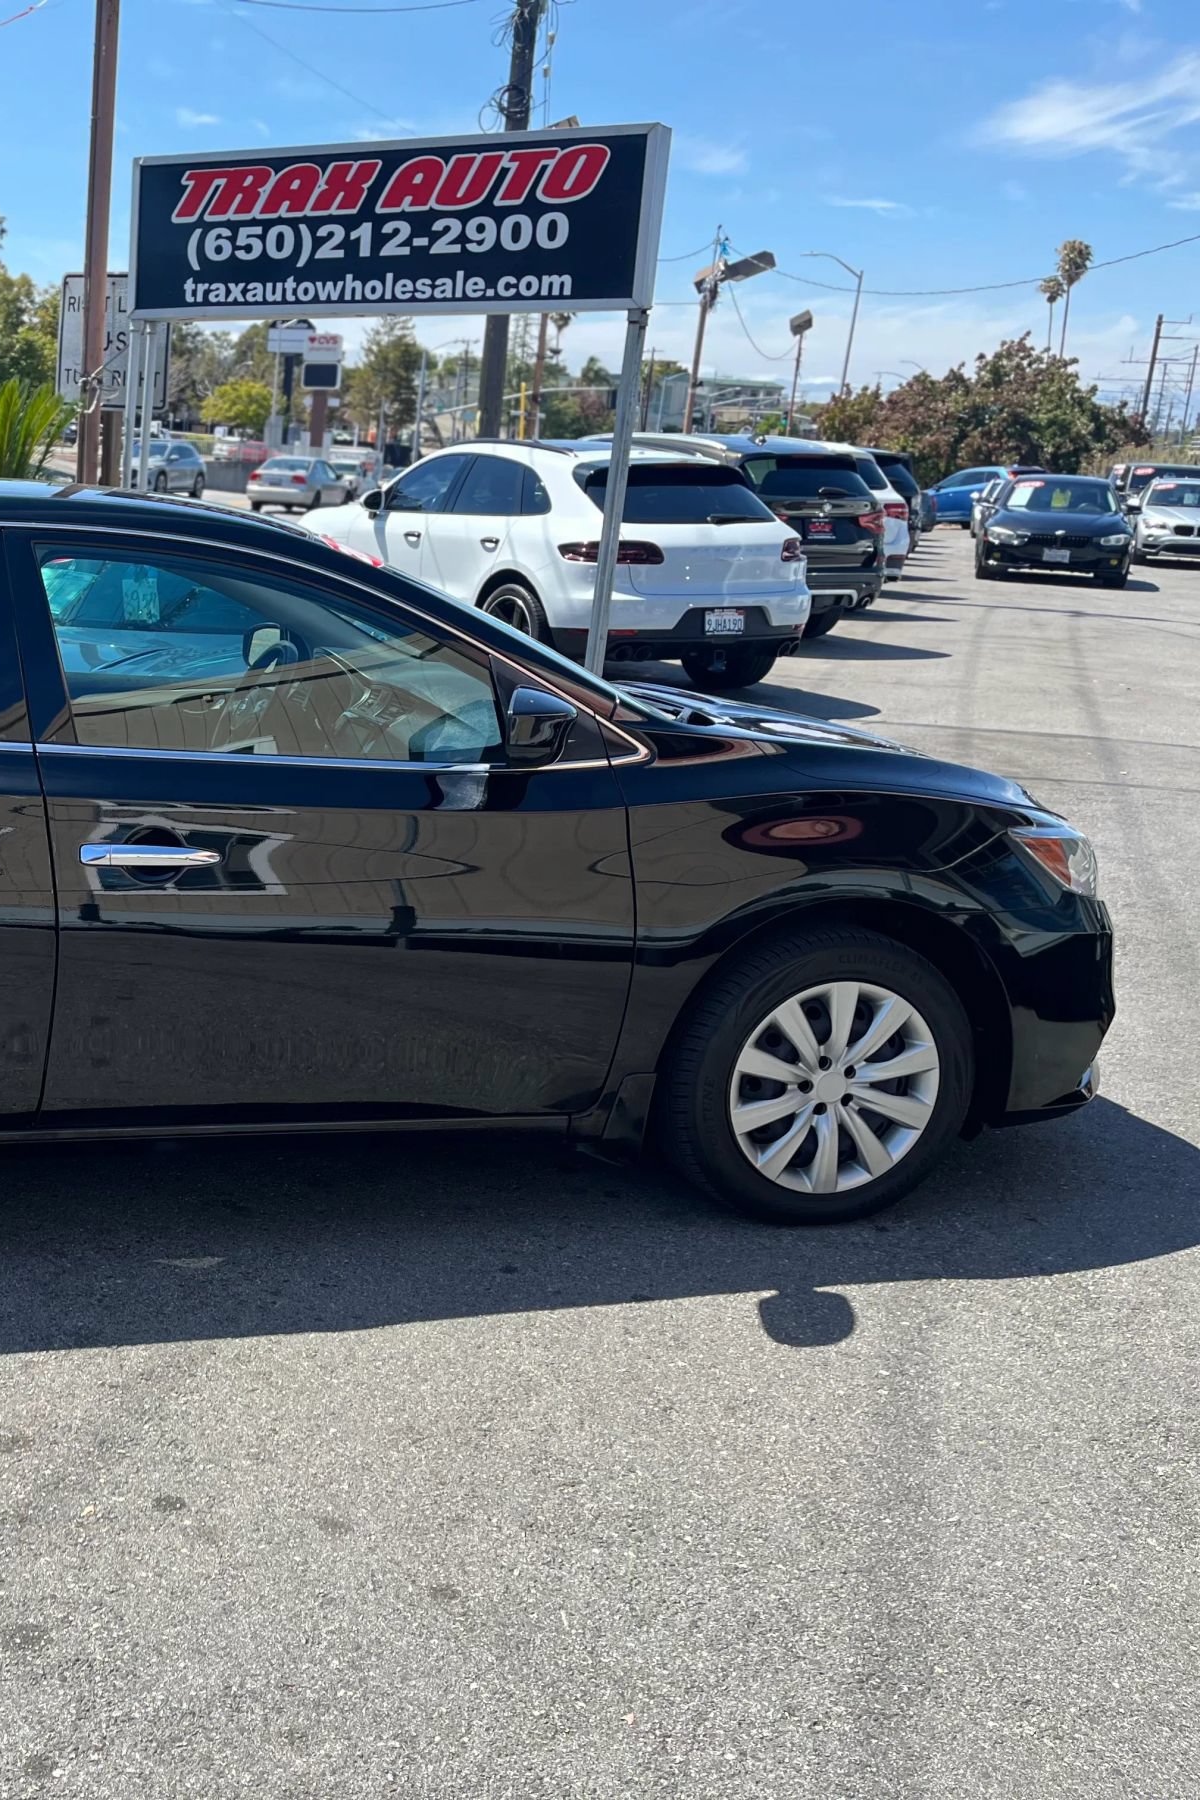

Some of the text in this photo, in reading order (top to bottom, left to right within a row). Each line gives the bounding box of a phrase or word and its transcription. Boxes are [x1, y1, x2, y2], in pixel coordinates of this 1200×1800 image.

[172, 143, 610, 223] TRAX AUTO
[187, 211, 570, 271] (650)212-2900
[184, 270, 573, 304] traxautowholesale.com
[318, 335, 338, 345] CVS
